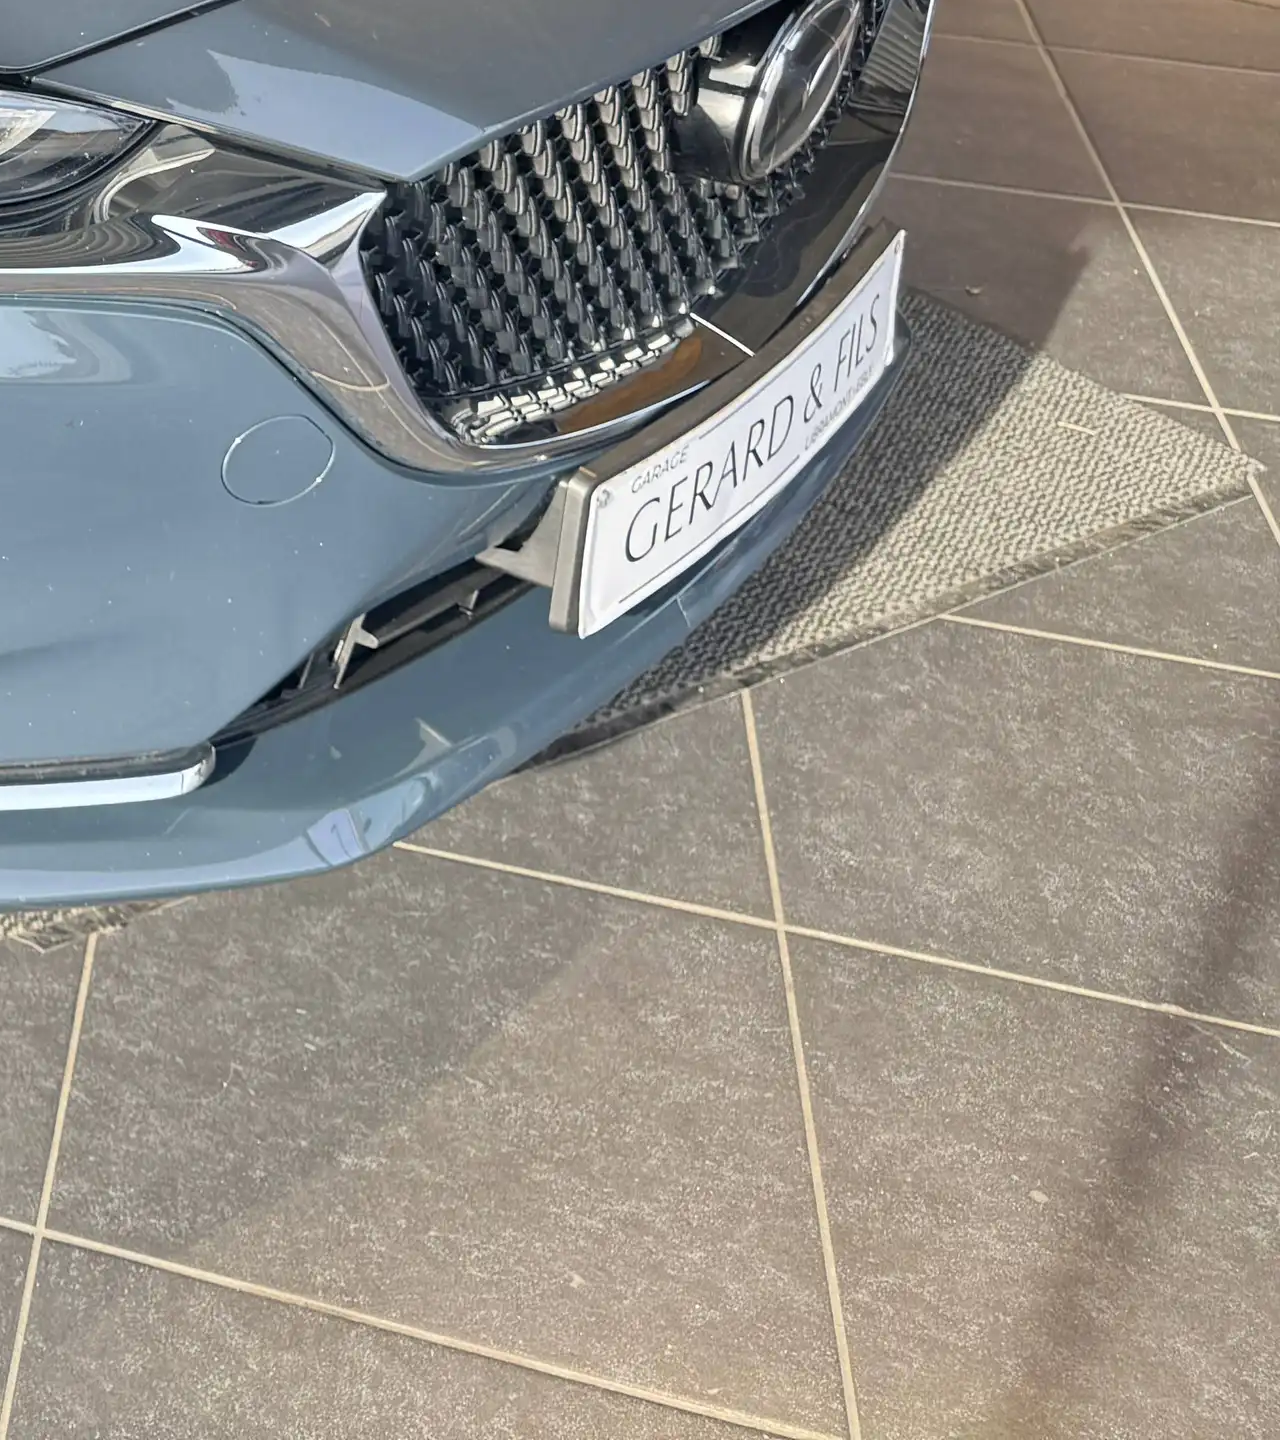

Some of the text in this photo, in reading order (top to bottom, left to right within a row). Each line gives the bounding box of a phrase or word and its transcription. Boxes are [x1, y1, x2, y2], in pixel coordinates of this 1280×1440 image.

[624, 293, 880, 563] GERARD & FILS
[631, 441, 691, 494] GARAGE
